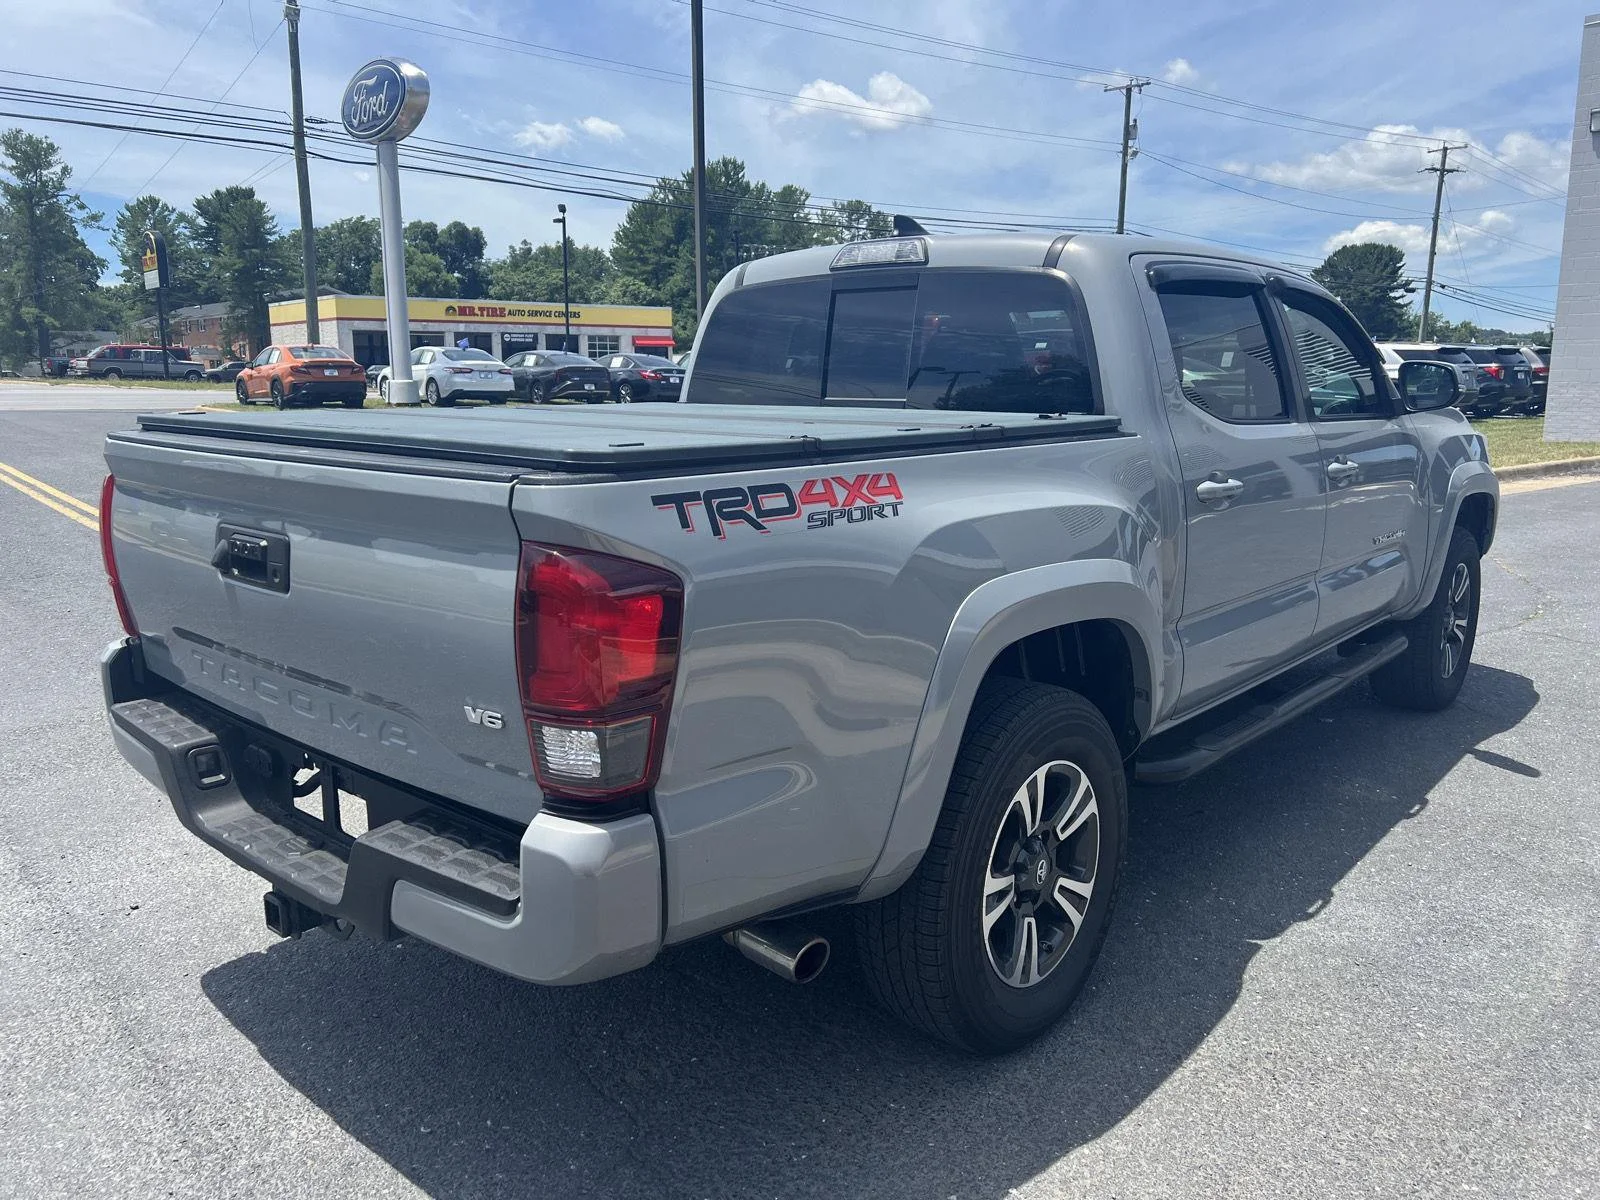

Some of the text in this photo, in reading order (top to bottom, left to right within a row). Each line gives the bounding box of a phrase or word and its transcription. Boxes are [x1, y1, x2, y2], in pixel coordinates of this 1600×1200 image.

[351, 75, 389, 127] Ford
[507, 309, 526, 317] AUTO
[527, 309, 552, 318] SERVICE
[553, 310, 581, 319] CENERS
[650, 482, 802, 540] TRD
[807, 501, 904, 529] SPORT
[191, 650, 418, 754] TACOMA
[463, 705, 505, 730] V6
